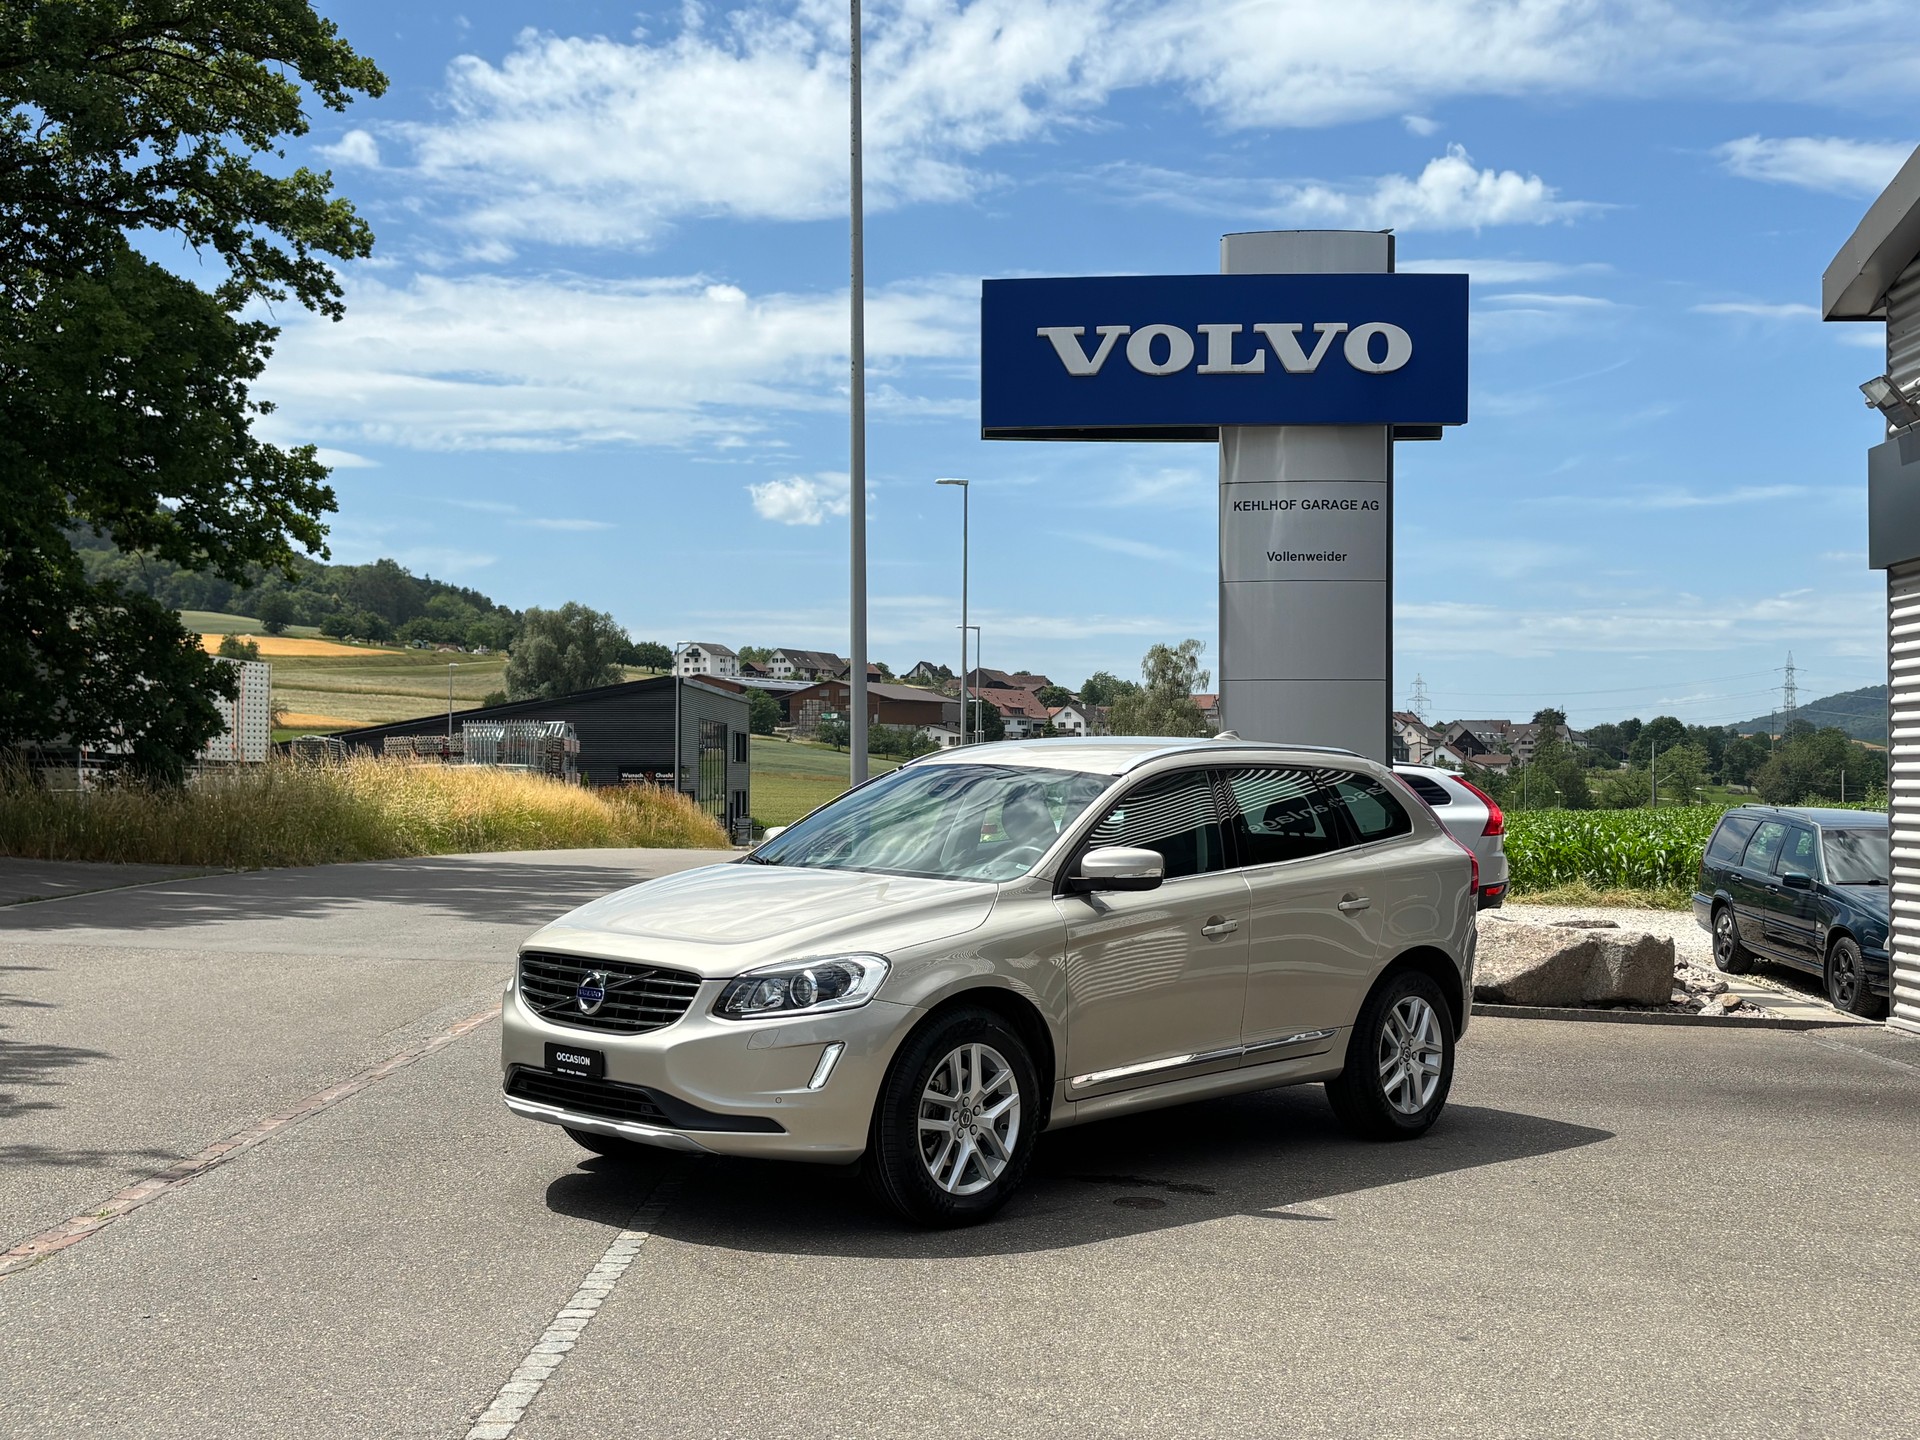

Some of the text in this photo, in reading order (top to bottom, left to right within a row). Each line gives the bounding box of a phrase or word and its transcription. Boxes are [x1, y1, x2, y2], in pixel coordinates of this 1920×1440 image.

[1036, 322, 1413, 376] VOLVO
[1233, 498, 1380, 512] KEHLHOF GARAGE AG
[1266, 550, 1348, 562] Vollenweider
[556, 1051, 591, 1066] OCCASION
